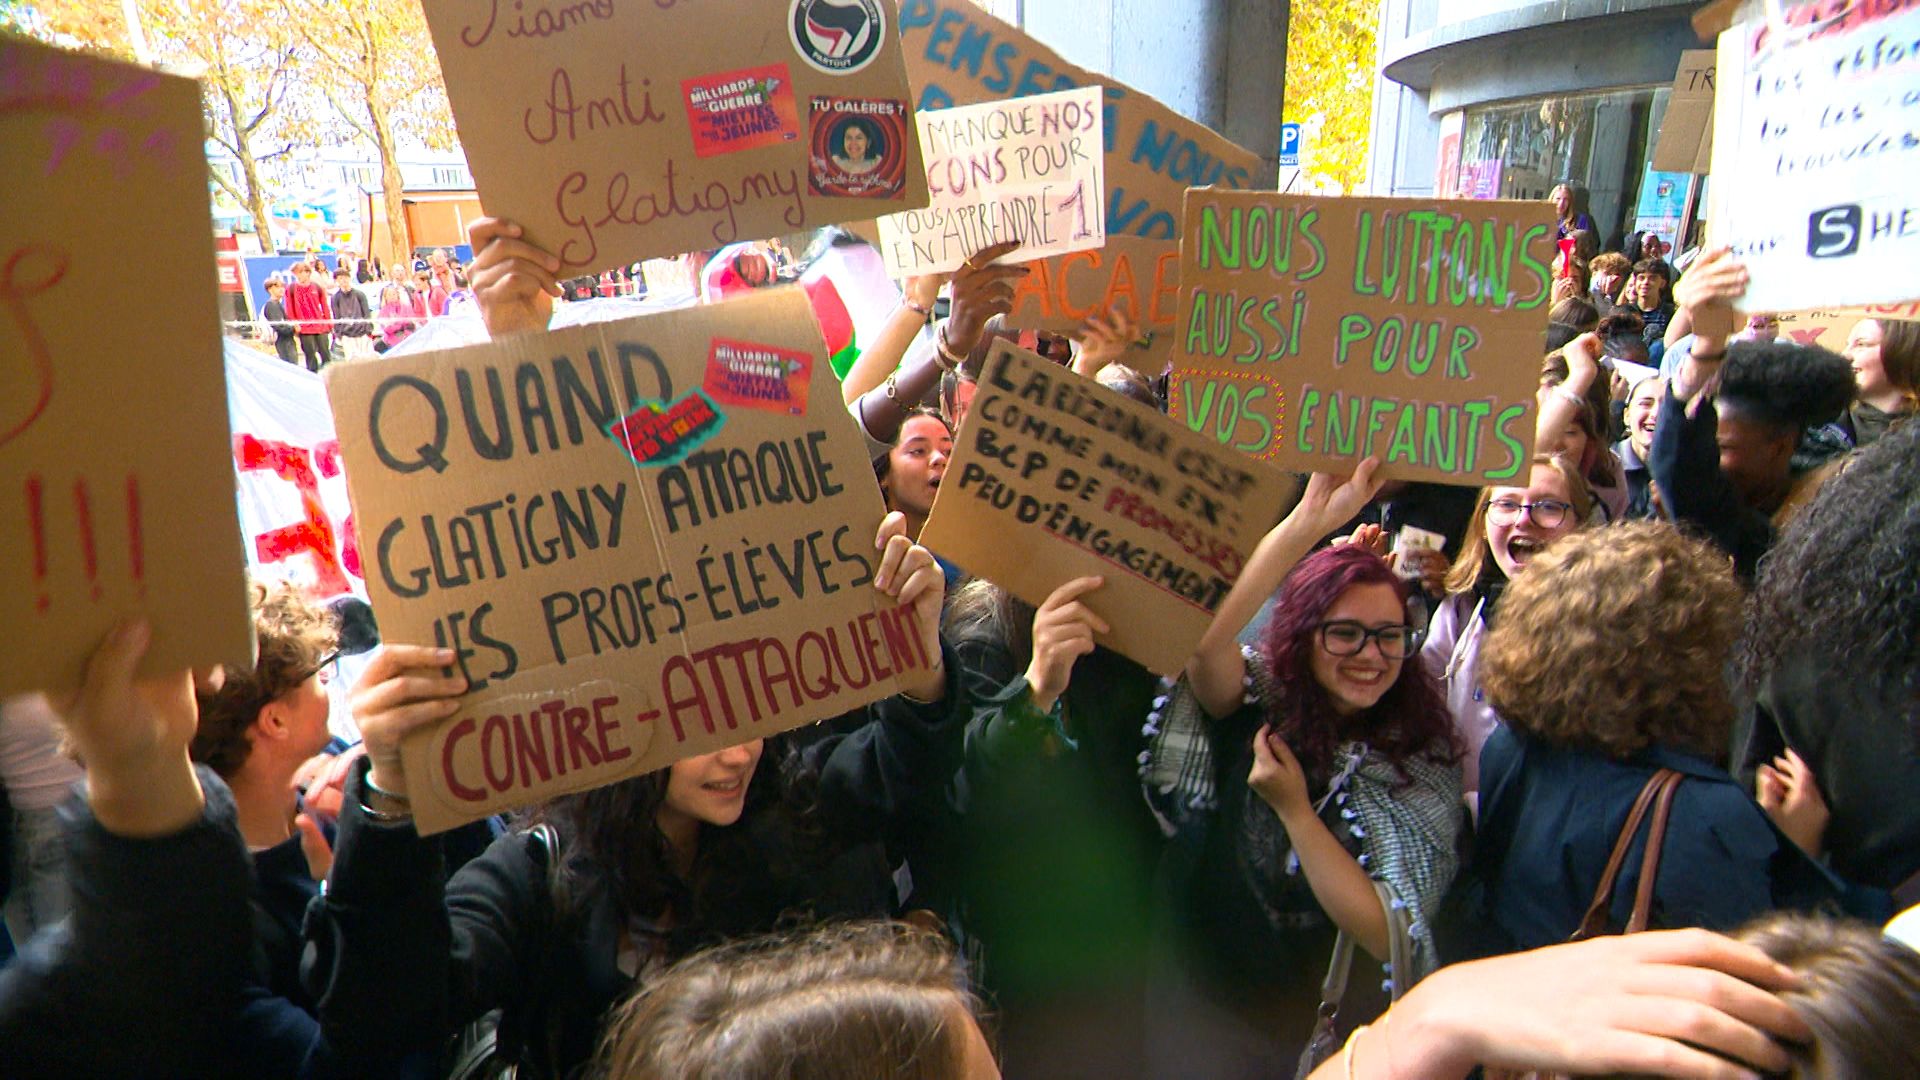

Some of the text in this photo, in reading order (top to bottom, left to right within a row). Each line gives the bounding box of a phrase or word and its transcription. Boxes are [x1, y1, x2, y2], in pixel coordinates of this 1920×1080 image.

[524, 63, 666, 144] Anti
[690, 77, 756, 103] MILLIARDS
[708, 92, 763, 113] GUERRE
[813, 99, 831, 112] TU
[833, 99, 895, 115] GALÈRES
[721, 114, 780, 142] JEUNES
[926, 100, 1095, 154] MANQUE NOS
[1014, 136, 1090, 180] POUR
[1281, 126, 1298, 151] P
[555, 158, 806, 267] Glatigny
[892, 207, 945, 235] VOUS
[893, 239, 935, 269] EN
[942, 185, 1058, 262] APPRENDRE
[1199, 205, 1553, 312] NOUS LUTTONS
[1185, 290, 1480, 380] AUSSI POUR
[368, 340, 674, 474] QUAND
[979, 394, 1094, 460] COMME
[1182, 379, 1527, 481] VOS ENFANTS
[957, 461, 1018, 512] PEU
[974, 427, 1049, 480] BCP
[1055, 467, 1101, 501] DE
[377, 480, 627, 600] GLATIGNY
[656, 430, 844, 533] ATTAQUE
